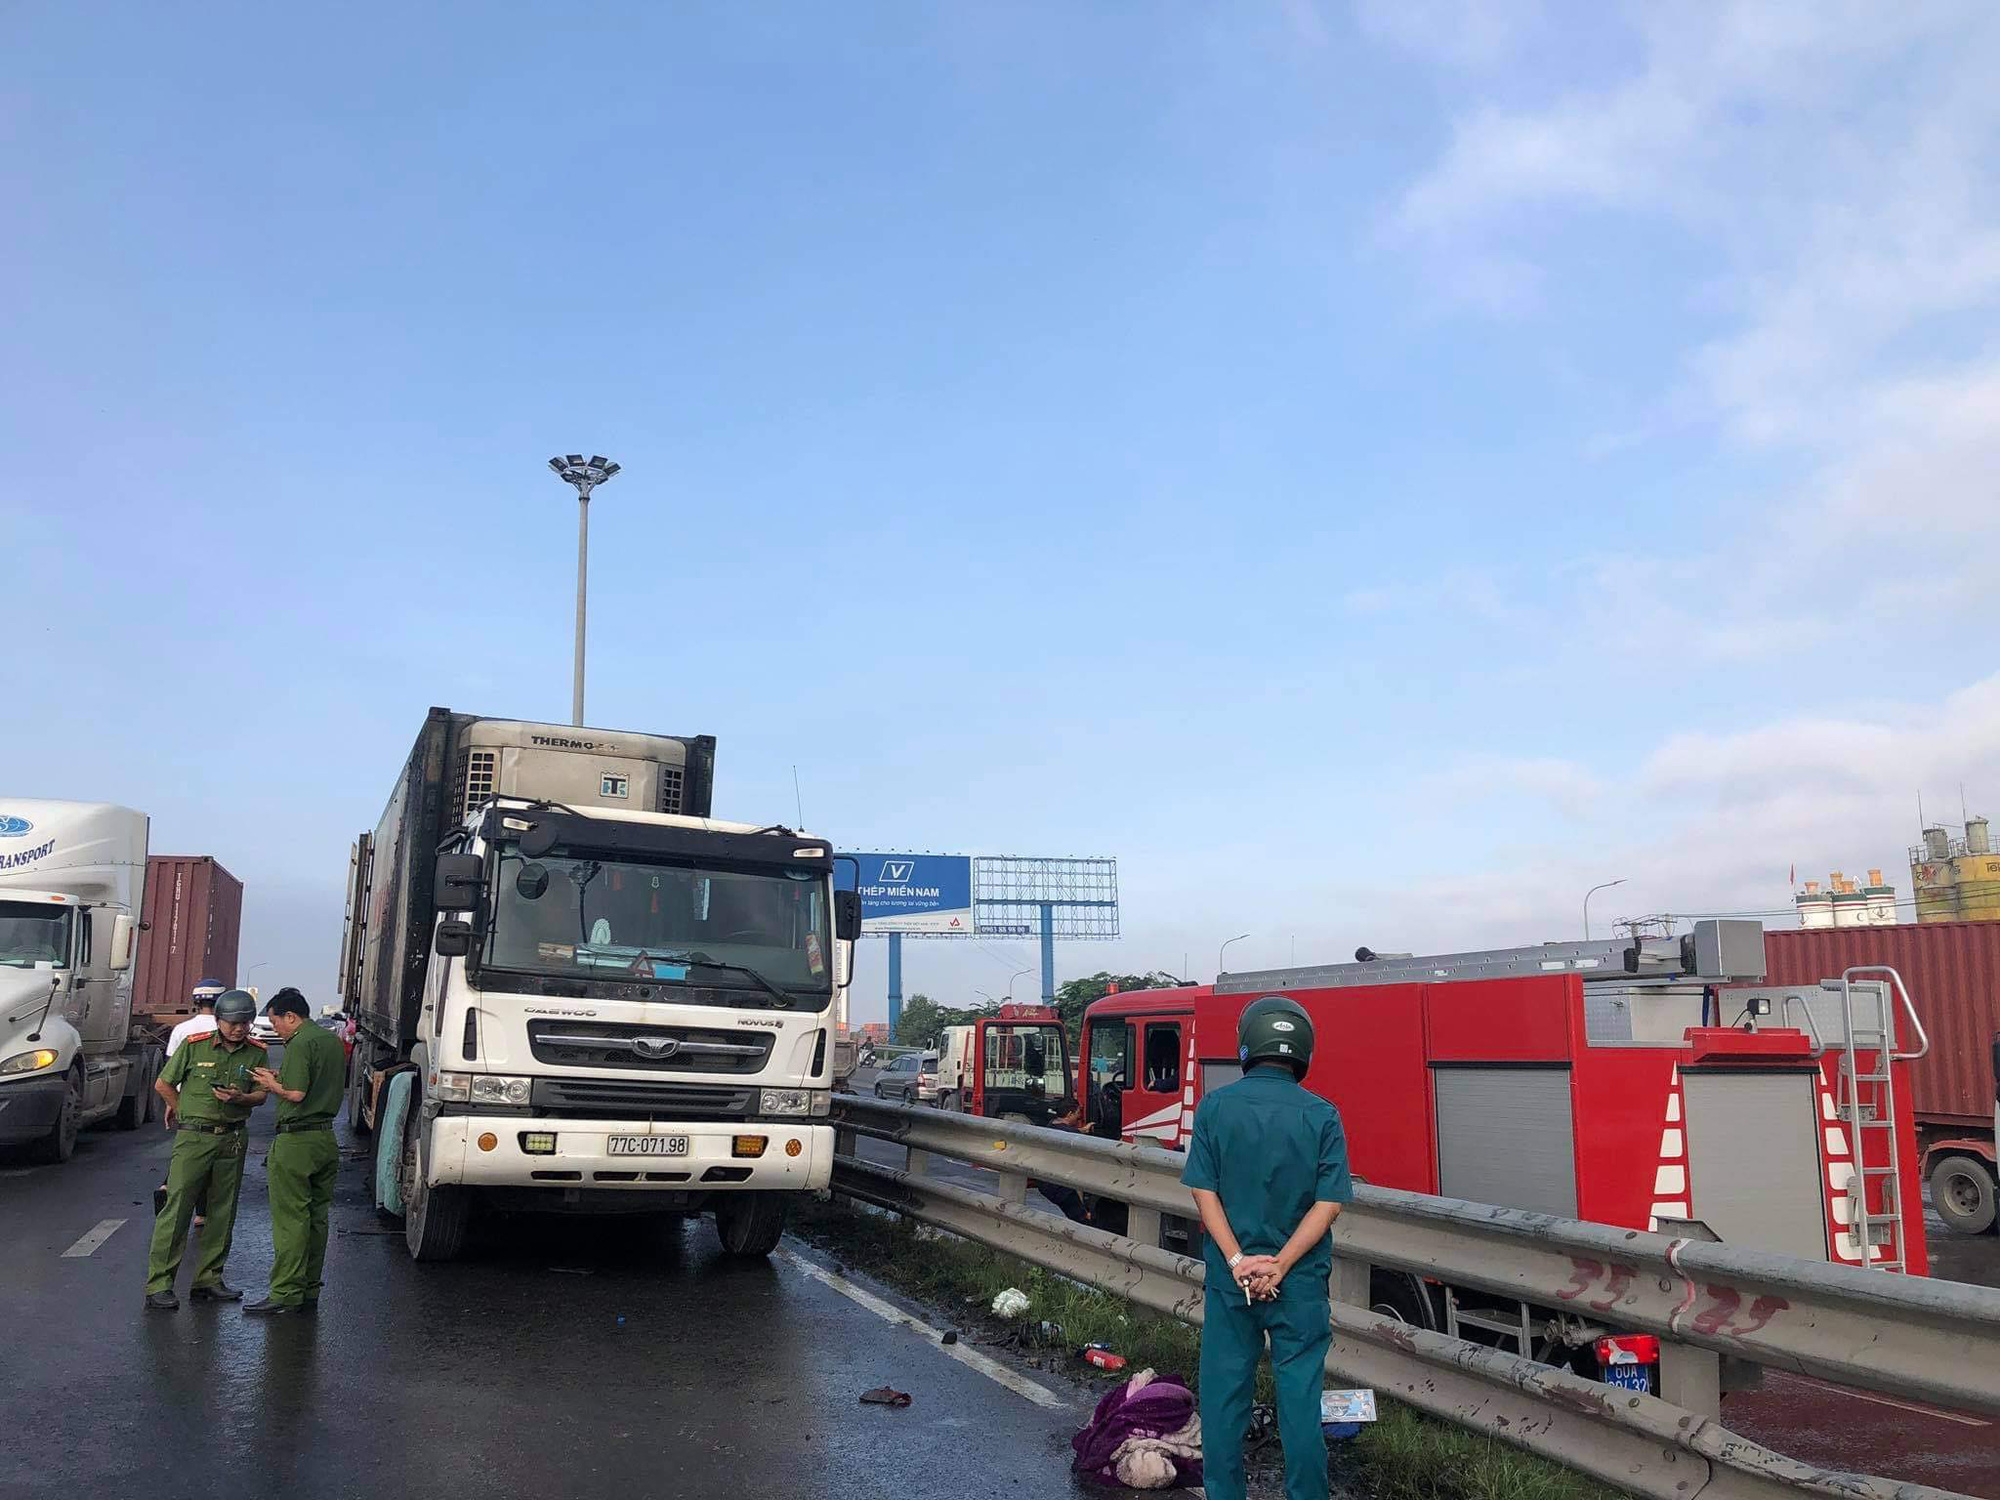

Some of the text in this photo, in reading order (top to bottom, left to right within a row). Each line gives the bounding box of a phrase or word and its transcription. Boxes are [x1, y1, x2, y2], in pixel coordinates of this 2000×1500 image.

[531, 735, 594, 750] THERMO
[916, 887, 940, 897] NAM
[524, 1007, 597, 1017] DAEWOO
[737, 1019, 774, 1027] NOVUS
[611, 1137, 685, 1153] 77C-071.98
